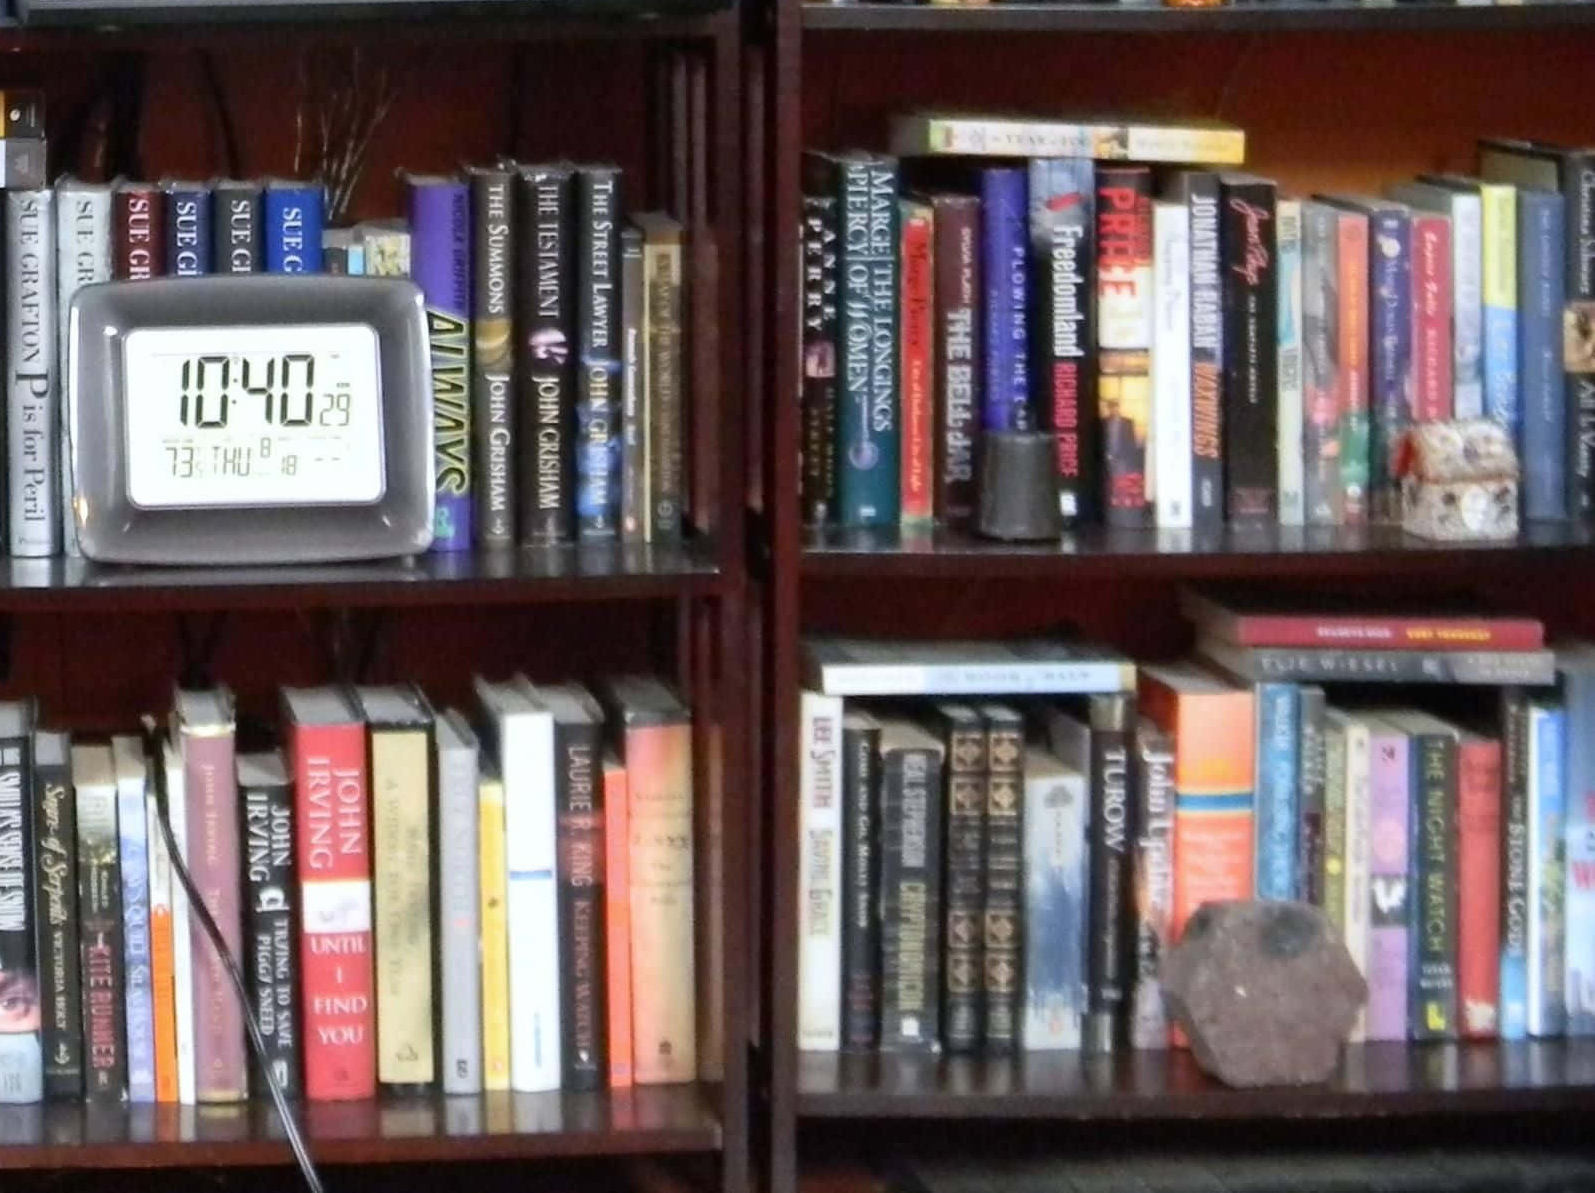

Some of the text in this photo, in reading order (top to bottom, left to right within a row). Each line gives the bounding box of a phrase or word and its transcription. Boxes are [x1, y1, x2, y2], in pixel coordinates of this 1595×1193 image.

[488, 184, 510, 315] THE SUMMONS
[846, 171, 871, 257] PIERCY
[869, 170, 896, 257] MARGE
[19, 200, 43, 362] SUE GRAFTON
[847, 265, 870, 300] OF
[1052, 224, 1085, 357] Freedomland
[871, 264, 896, 432] THE LONGINGS
[179, 354, 351, 429] 10:40 29
[15, 367, 51, 523] P is for Peril
[165, 436, 299, 478] 73 THU 8 18
[485, 373, 513, 512] JOHN GRISHAM
[246, 793, 270, 881] IRVING
[272, 805, 292, 867] JOHN
[307, 757, 334, 870] IRVING
[335, 769, 362, 855] JOHN
[1104, 744, 1129, 853] TUROW
[310, 937, 365, 954] UNTIL
[336, 967, 344, 984] I
[313, 998, 367, 1015] FIND
[317, 1027, 363, 1045] YOU
